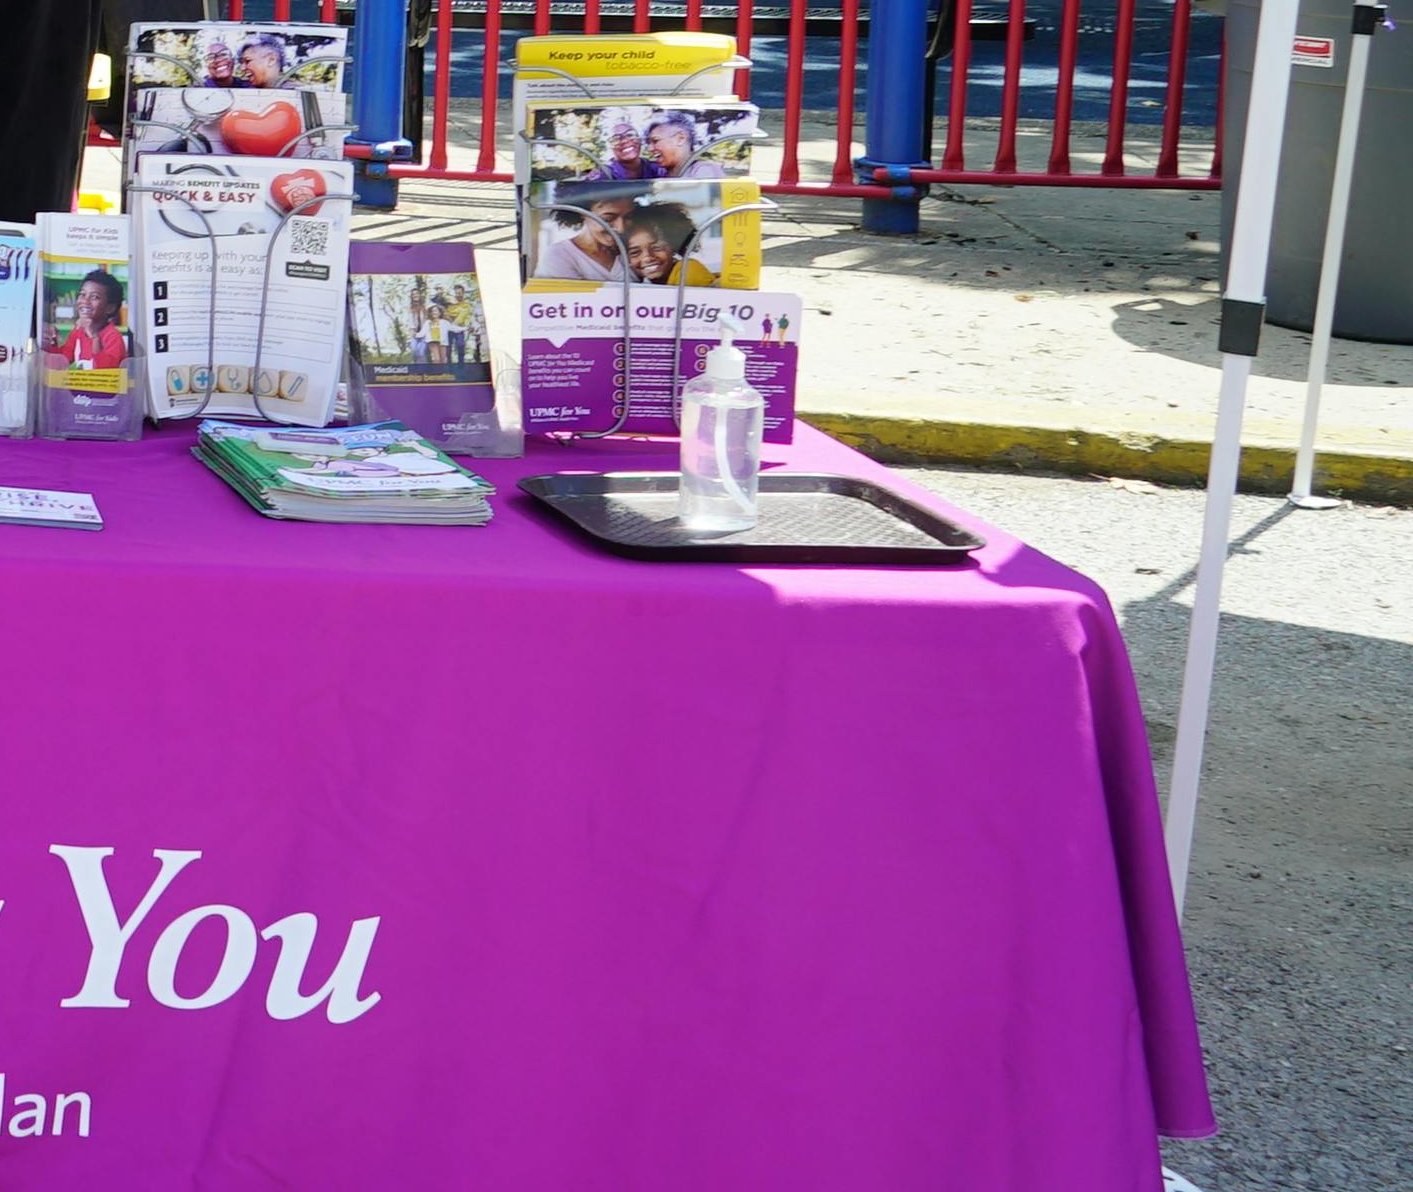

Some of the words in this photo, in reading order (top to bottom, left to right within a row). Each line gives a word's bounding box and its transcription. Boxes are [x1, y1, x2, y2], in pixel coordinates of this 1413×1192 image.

[548, 51, 583, 61] Keep
[587, 51, 620, 61] your
[621, 50, 656, 59] child
[605, 60, 692, 71] tobacco-free
[203, 191, 214, 201] &
[218, 192, 256, 203] EASY
[152, 250, 191, 262] Keeping
[195, 251, 209, 262] up
[152, 262, 192, 272] benefits
[195, 263, 204, 272] is
[221, 265, 246, 276] easy
[529, 303, 568, 319] Get
[574, 302, 593, 318] in
[601, 305, 626, 318] on
[636, 306, 676, 318] our
[682, 303, 721, 323] Big
[529, 407, 560, 417] UPMC
[48, 842, 383, 1025] You
